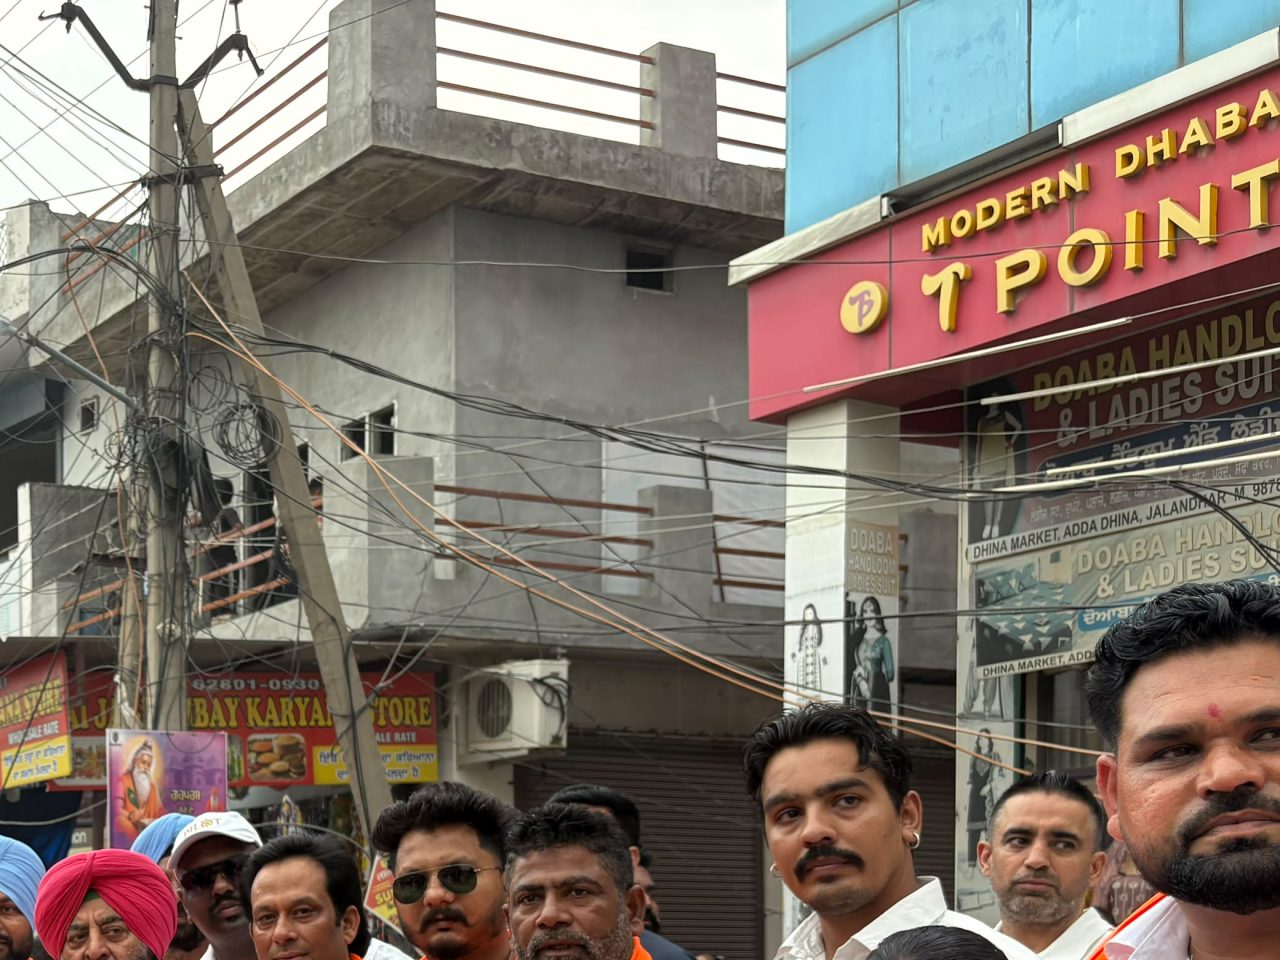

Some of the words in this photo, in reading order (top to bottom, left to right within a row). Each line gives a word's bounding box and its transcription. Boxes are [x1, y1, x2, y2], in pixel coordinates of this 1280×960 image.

[921, 162, 1090, 253] MODERN
[1114, 88, 1280, 179] DHABA
[995, 159, 1280, 315] POINT
[1033, 345, 1138, 412] DOABA
[1057, 407, 1078, 448] &
[1089, 371, 1203, 439] LADIES
[1214, 354, 1280, 406] SUI
[850, 527, 894, 555] DOABA
[973, 541, 1008, 559] DHINA
[1063, 519, 1098, 539] ADDA
[1146, 490, 1227, 520] JALANDHAR
[847, 556, 896, 574] HANDLOOM
[1078, 533, 1167, 575] DOABA
[877, 578, 896, 595] SUIT
[1097, 573, 1116, 599] &
[1124, 552, 1221, 594] LADIES
[982, 662, 1016, 678] DHINA
[1068, 650, 1096, 663] ADD
[191, 677, 324, 692] 62801-0930
[246, 695, 335, 729] KARYA
[394, 731, 417, 743] RATE
